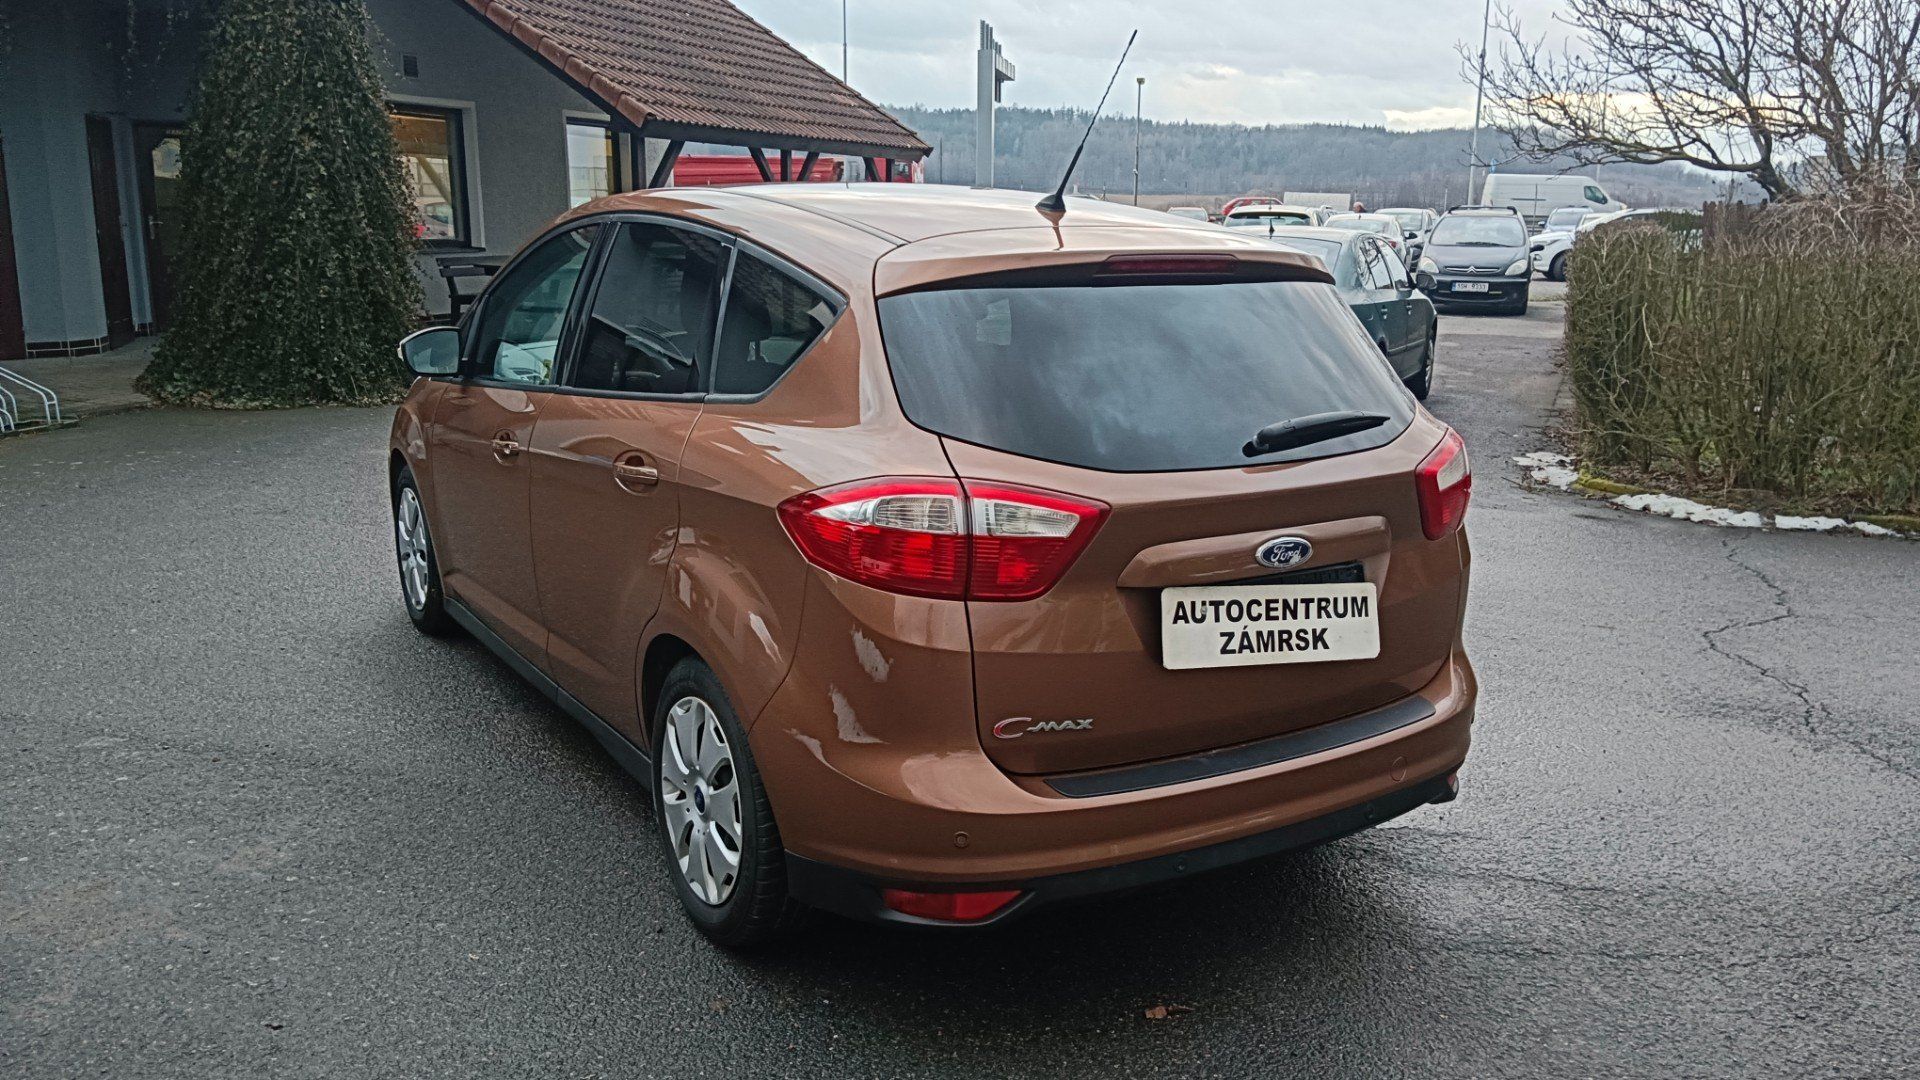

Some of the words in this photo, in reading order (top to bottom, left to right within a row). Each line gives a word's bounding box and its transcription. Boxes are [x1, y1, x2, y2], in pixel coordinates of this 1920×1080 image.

[1270, 543, 1302, 563] Ford
[1172, 596, 1369, 624] AUTOCENTRUM
[1219, 625, 1330, 655] ZÁMRSK
